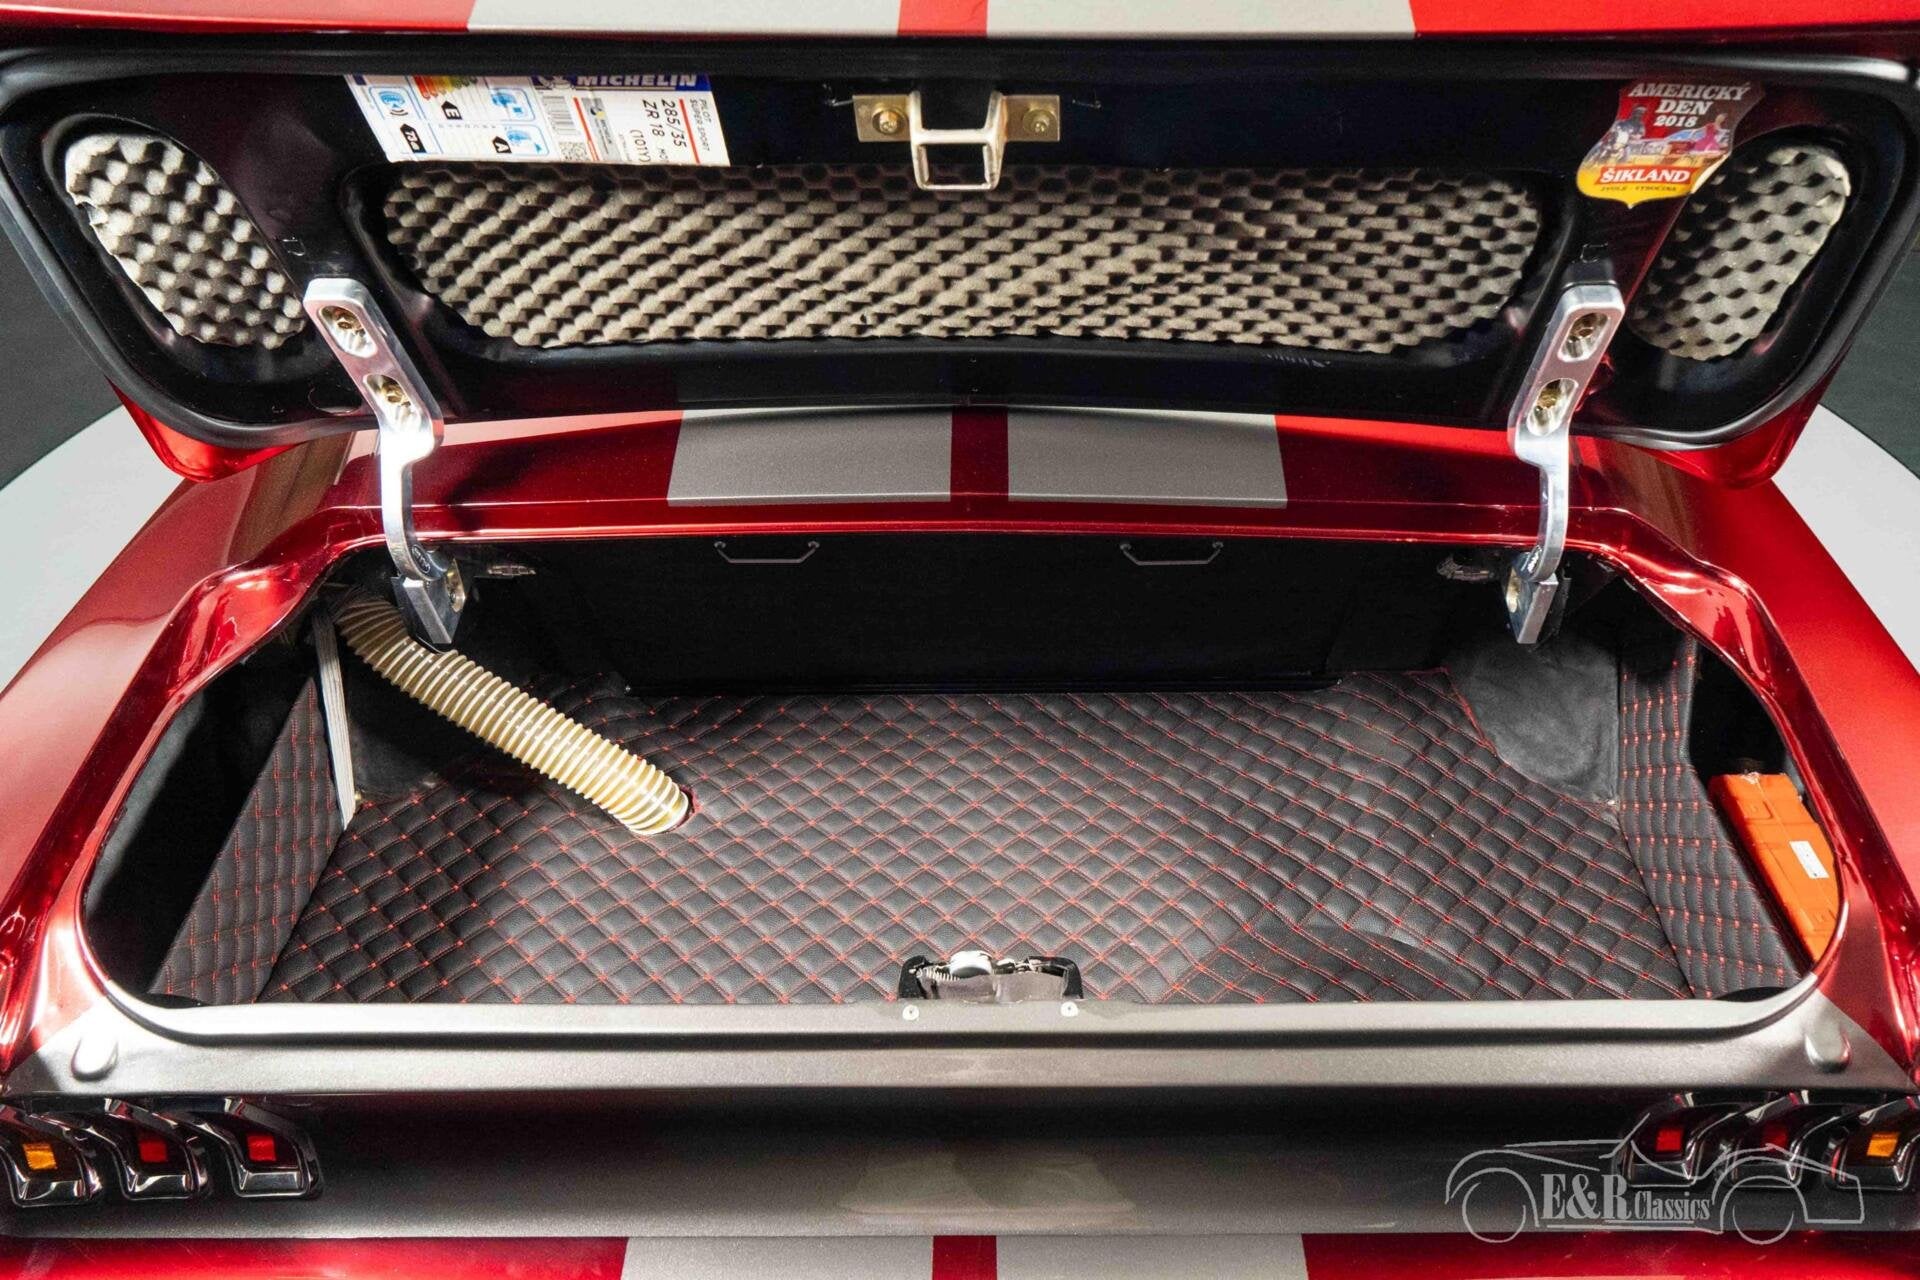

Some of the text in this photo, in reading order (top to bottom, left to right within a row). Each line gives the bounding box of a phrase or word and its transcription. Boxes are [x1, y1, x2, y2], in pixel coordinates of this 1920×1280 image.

[577, 75, 697, 87] MICHELIN
[1628, 82, 1750, 100] AMERICKÝ
[642, 99, 660, 119] ZR
[1655, 100, 1713, 115] DEN
[661, 98, 687, 148] 285/35
[1653, 115, 1698, 127] 2018
[650, 123, 665, 137] 18
